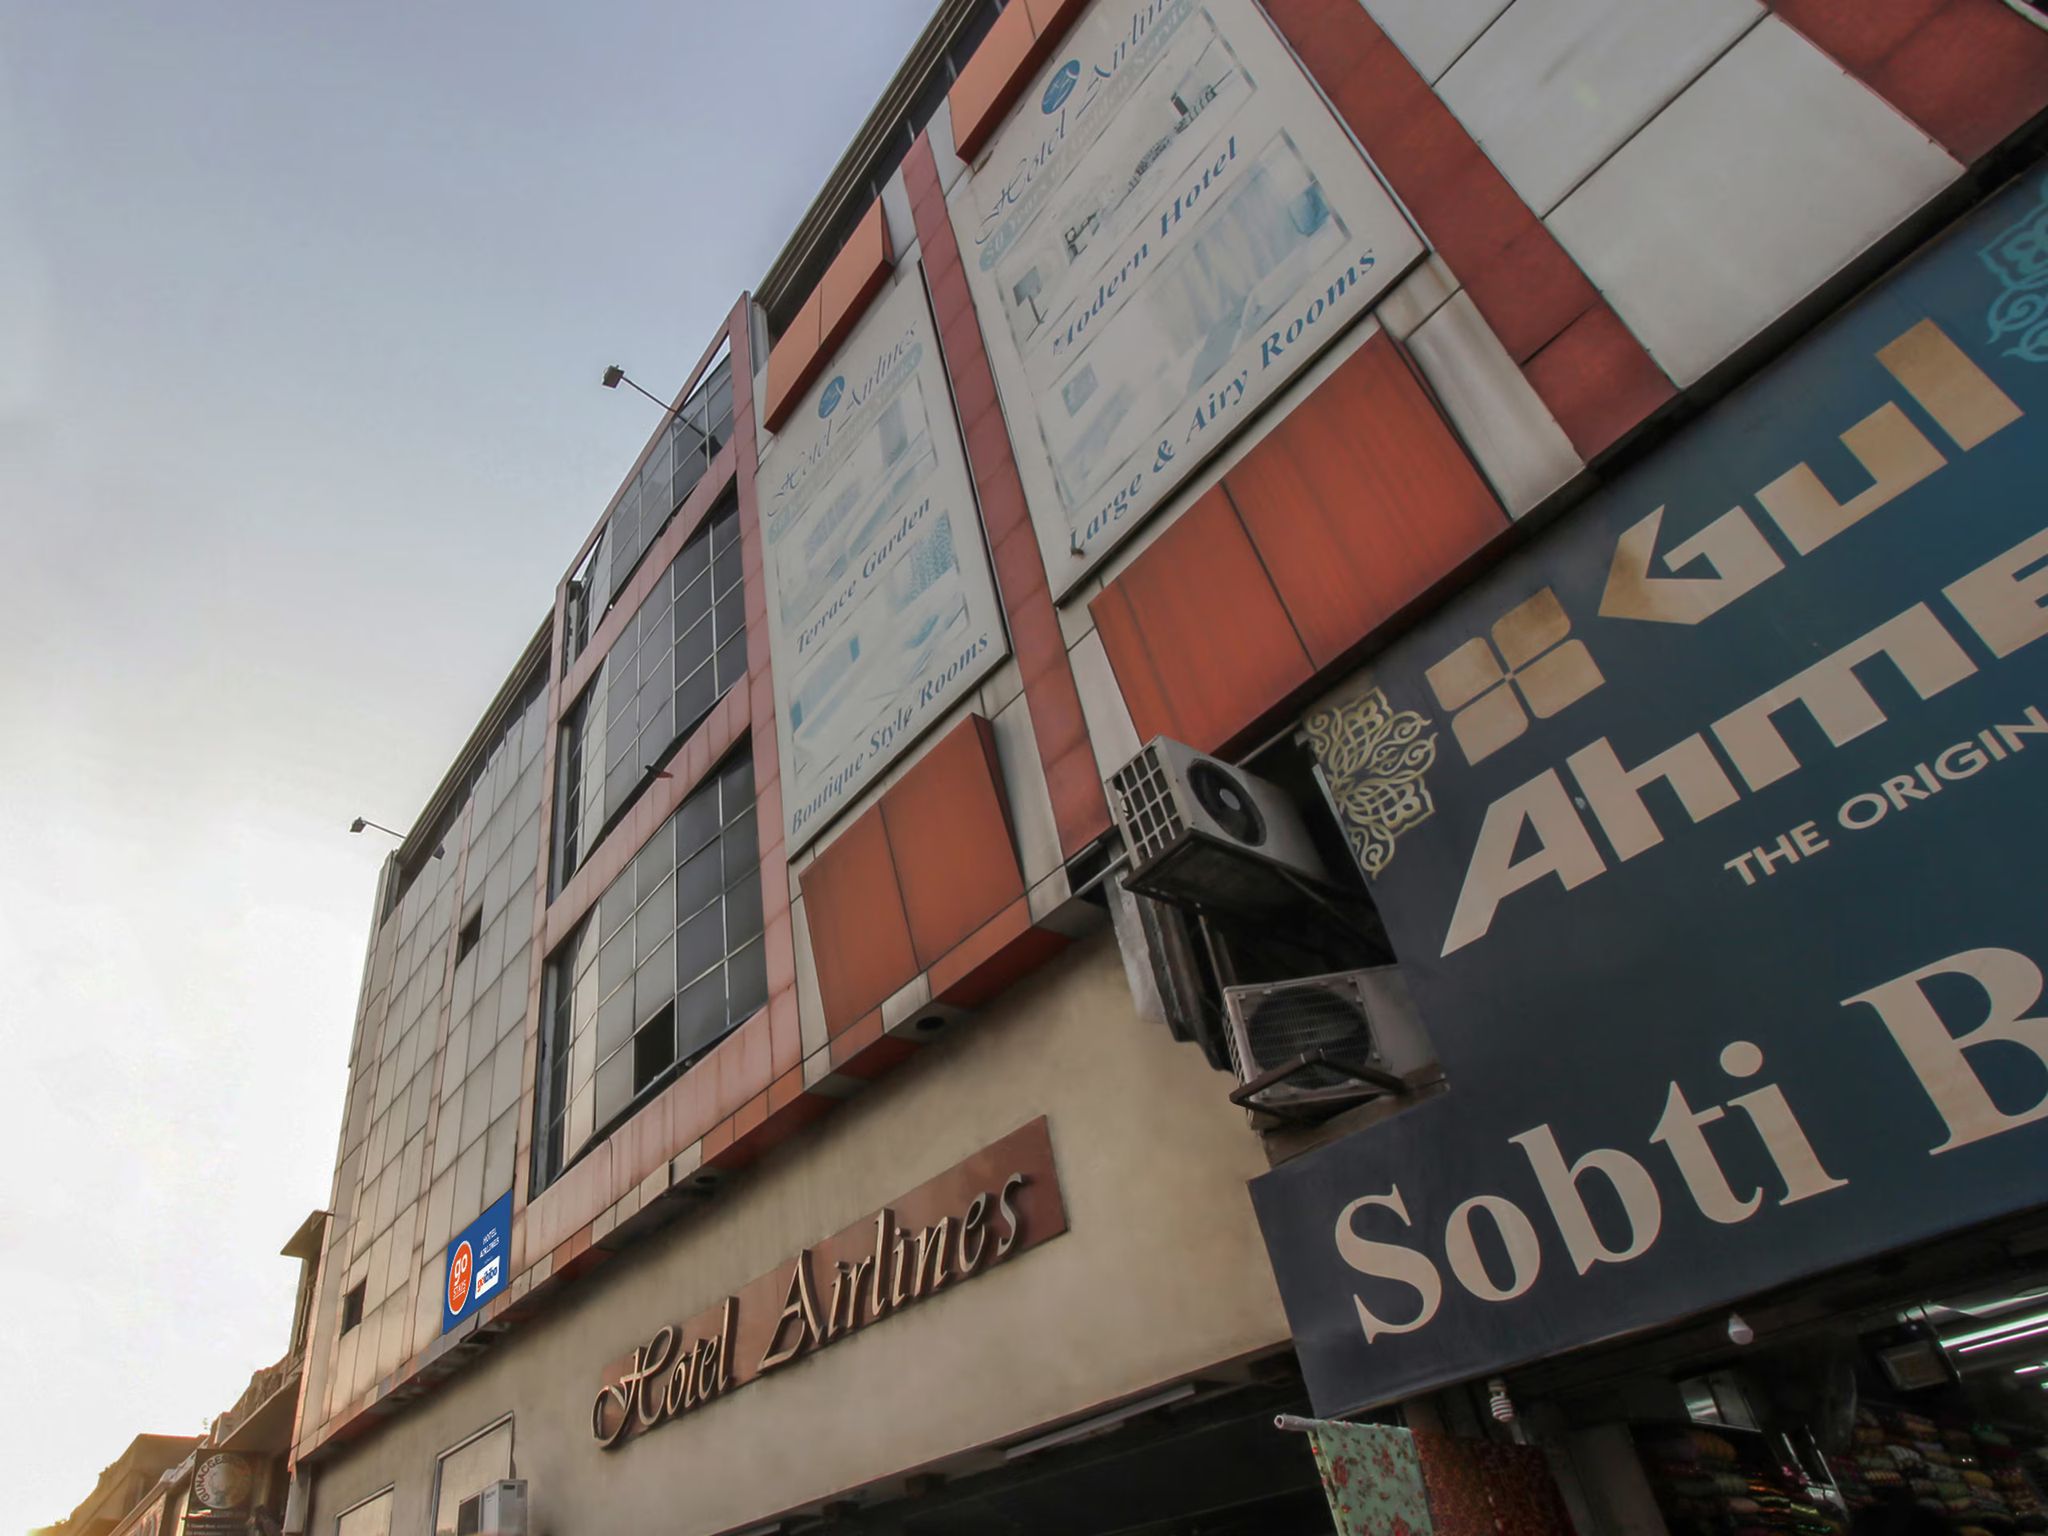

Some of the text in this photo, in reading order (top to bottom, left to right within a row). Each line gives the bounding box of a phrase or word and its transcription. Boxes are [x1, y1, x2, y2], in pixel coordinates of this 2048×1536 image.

[1075, 0, 1169, 120] Airlin
[1160, 136, 1236, 239] Hotel
[1070, 248, 1376, 551] Large & Airy Rooms
[797, 580, 856, 653] Terrace
[863, 498, 930, 579] Garden
[792, 632, 989, 836] Boutique Style Rooms
[1724, 705, 2048, 886] THE ORIGIN
[1334, 946, 2048, 1345] Sobti B
[454, 1253, 468, 1287] go
[591, 1172, 1027, 1447] Hotel Airlines
